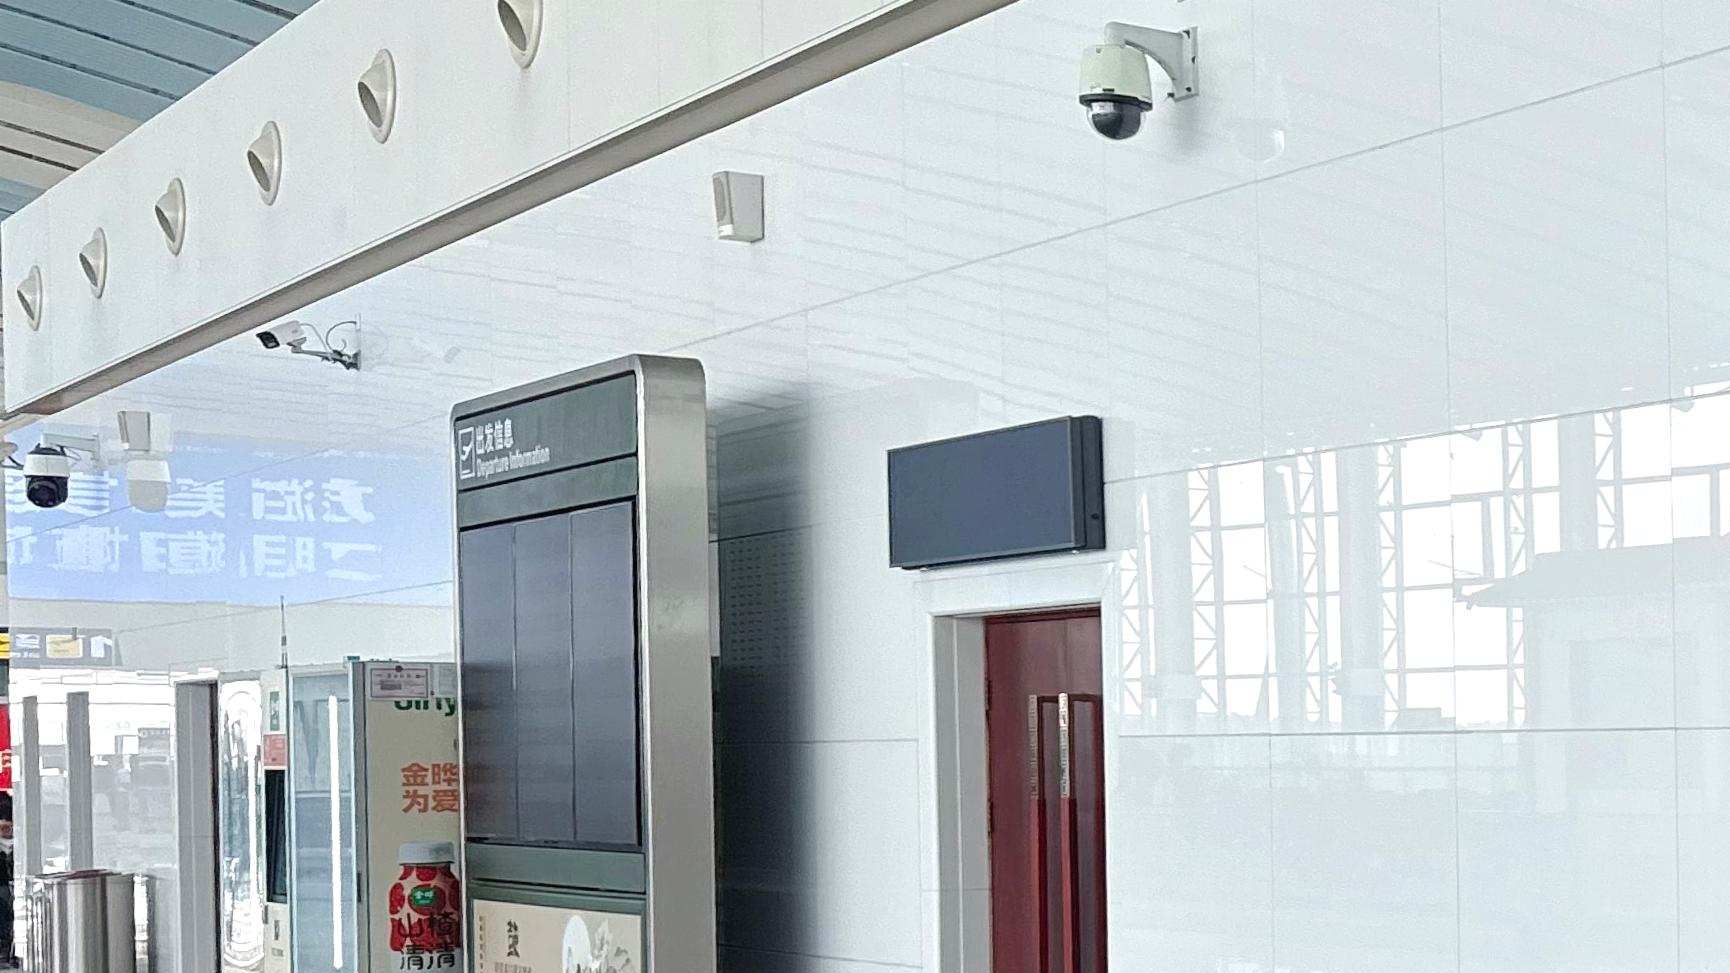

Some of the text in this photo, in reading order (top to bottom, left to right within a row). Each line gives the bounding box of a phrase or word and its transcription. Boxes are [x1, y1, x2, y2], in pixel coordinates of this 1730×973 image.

[476, 417, 514, 455] 出发信息
[477, 444, 550, 481] Departure Information
[401, 789, 459, 814] 为爱
